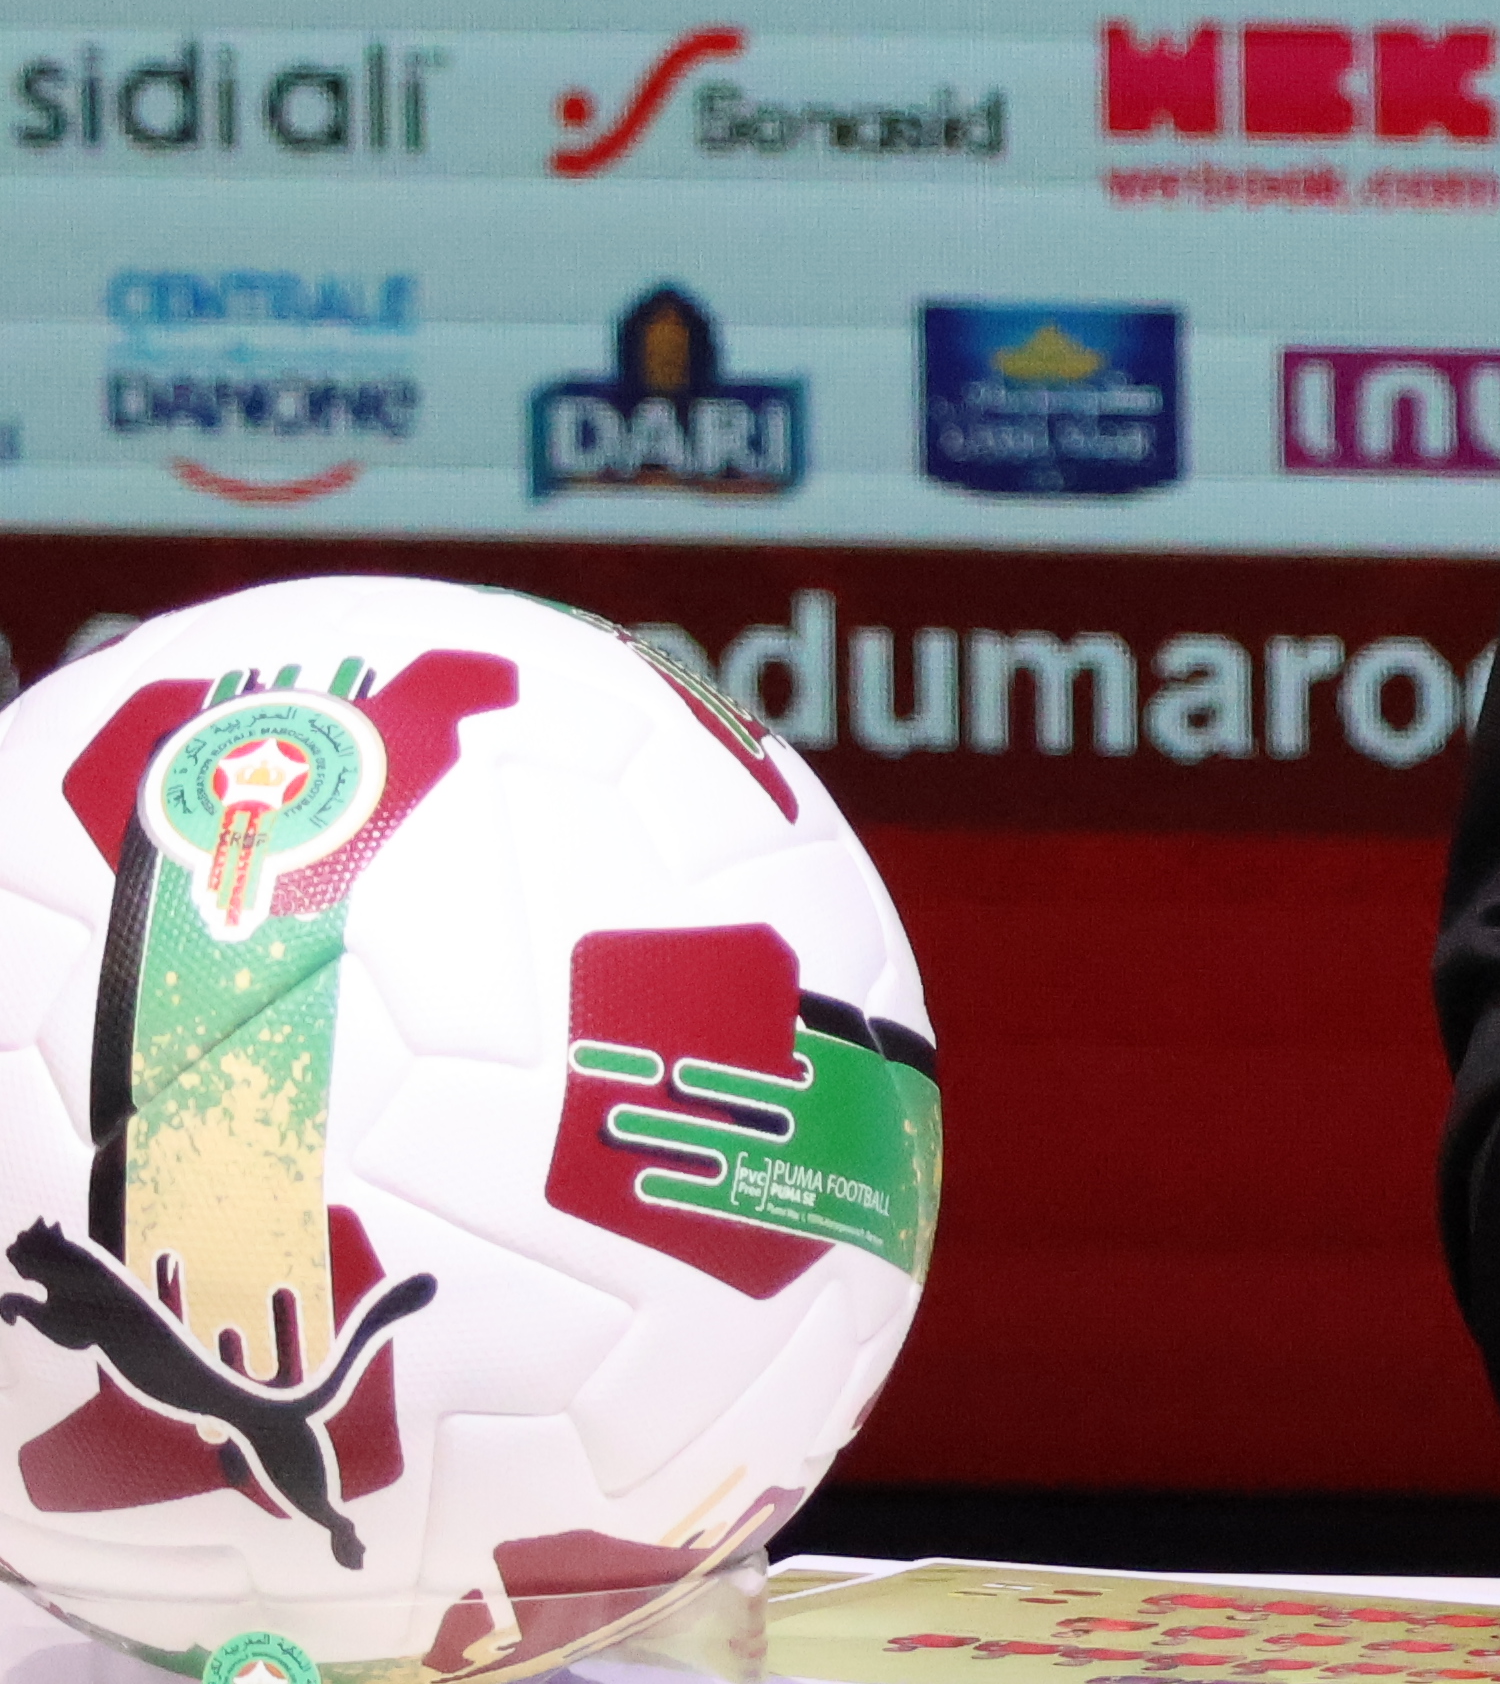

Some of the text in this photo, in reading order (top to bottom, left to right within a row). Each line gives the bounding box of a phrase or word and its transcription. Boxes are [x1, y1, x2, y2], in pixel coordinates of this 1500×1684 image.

[546, 396, 790, 478] DARI
[630, 588, 1498, 768] dumaro
[739, 1167, 768, 1186] PVC
[772, 1159, 891, 1217] PUMA FOOTBALL
